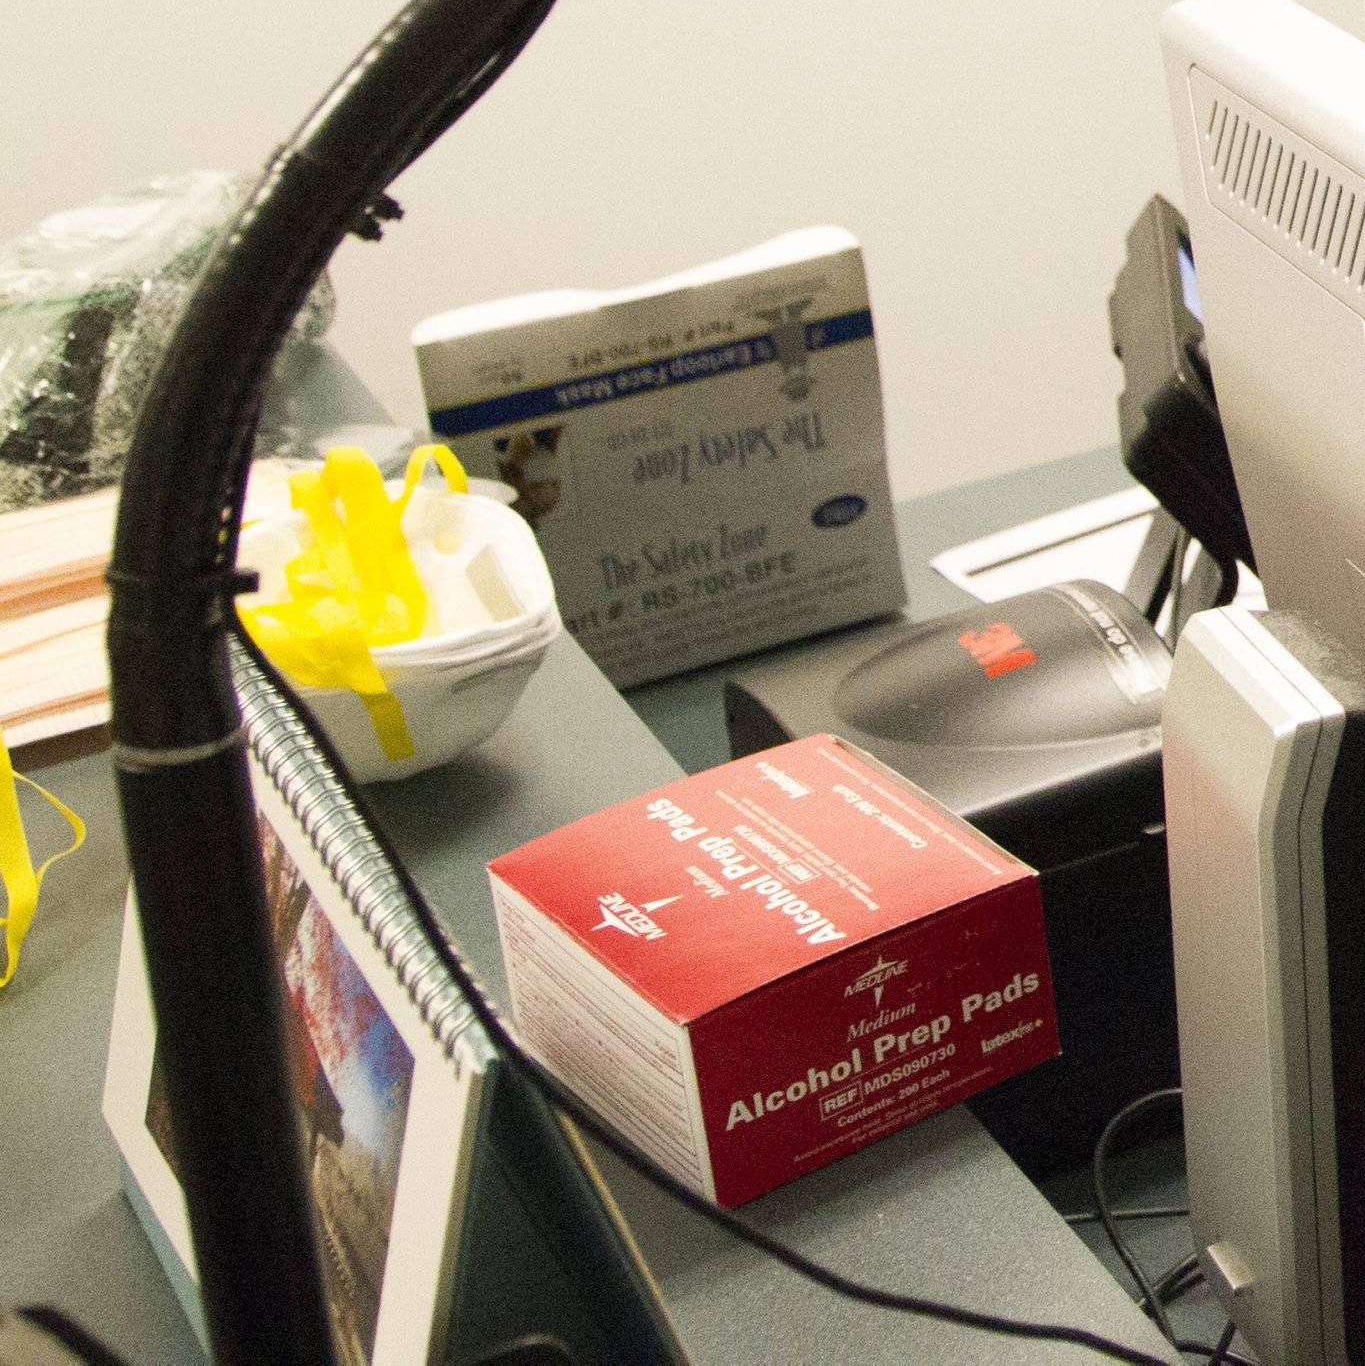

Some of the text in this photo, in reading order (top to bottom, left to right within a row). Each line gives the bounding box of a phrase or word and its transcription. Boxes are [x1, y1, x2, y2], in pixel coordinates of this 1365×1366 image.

[556, 378, 613, 406] Mask
[616, 366, 670, 394] Face
[702, 429, 779, 470] Safety
[783, 411, 828, 452] The
[631, 442, 693, 486] Zone
[599, 522, 768, 591] The Safety Zone
[646, 797, 709, 843] Pads
[698, 836, 759, 881] Prep
[597, 891, 668, 941] MEDLINE
[740, 874, 848, 945] Alcohol
[844, 959, 909, 998] MEDLINE
[846, 1001, 917, 1044] Medium
[725, 972, 1040, 1132] Alcohol Prep Pads
[822, 1042, 956, 1115] REF MDS090730
[837, 1068, 951, 1128] Contents: 200 Each
